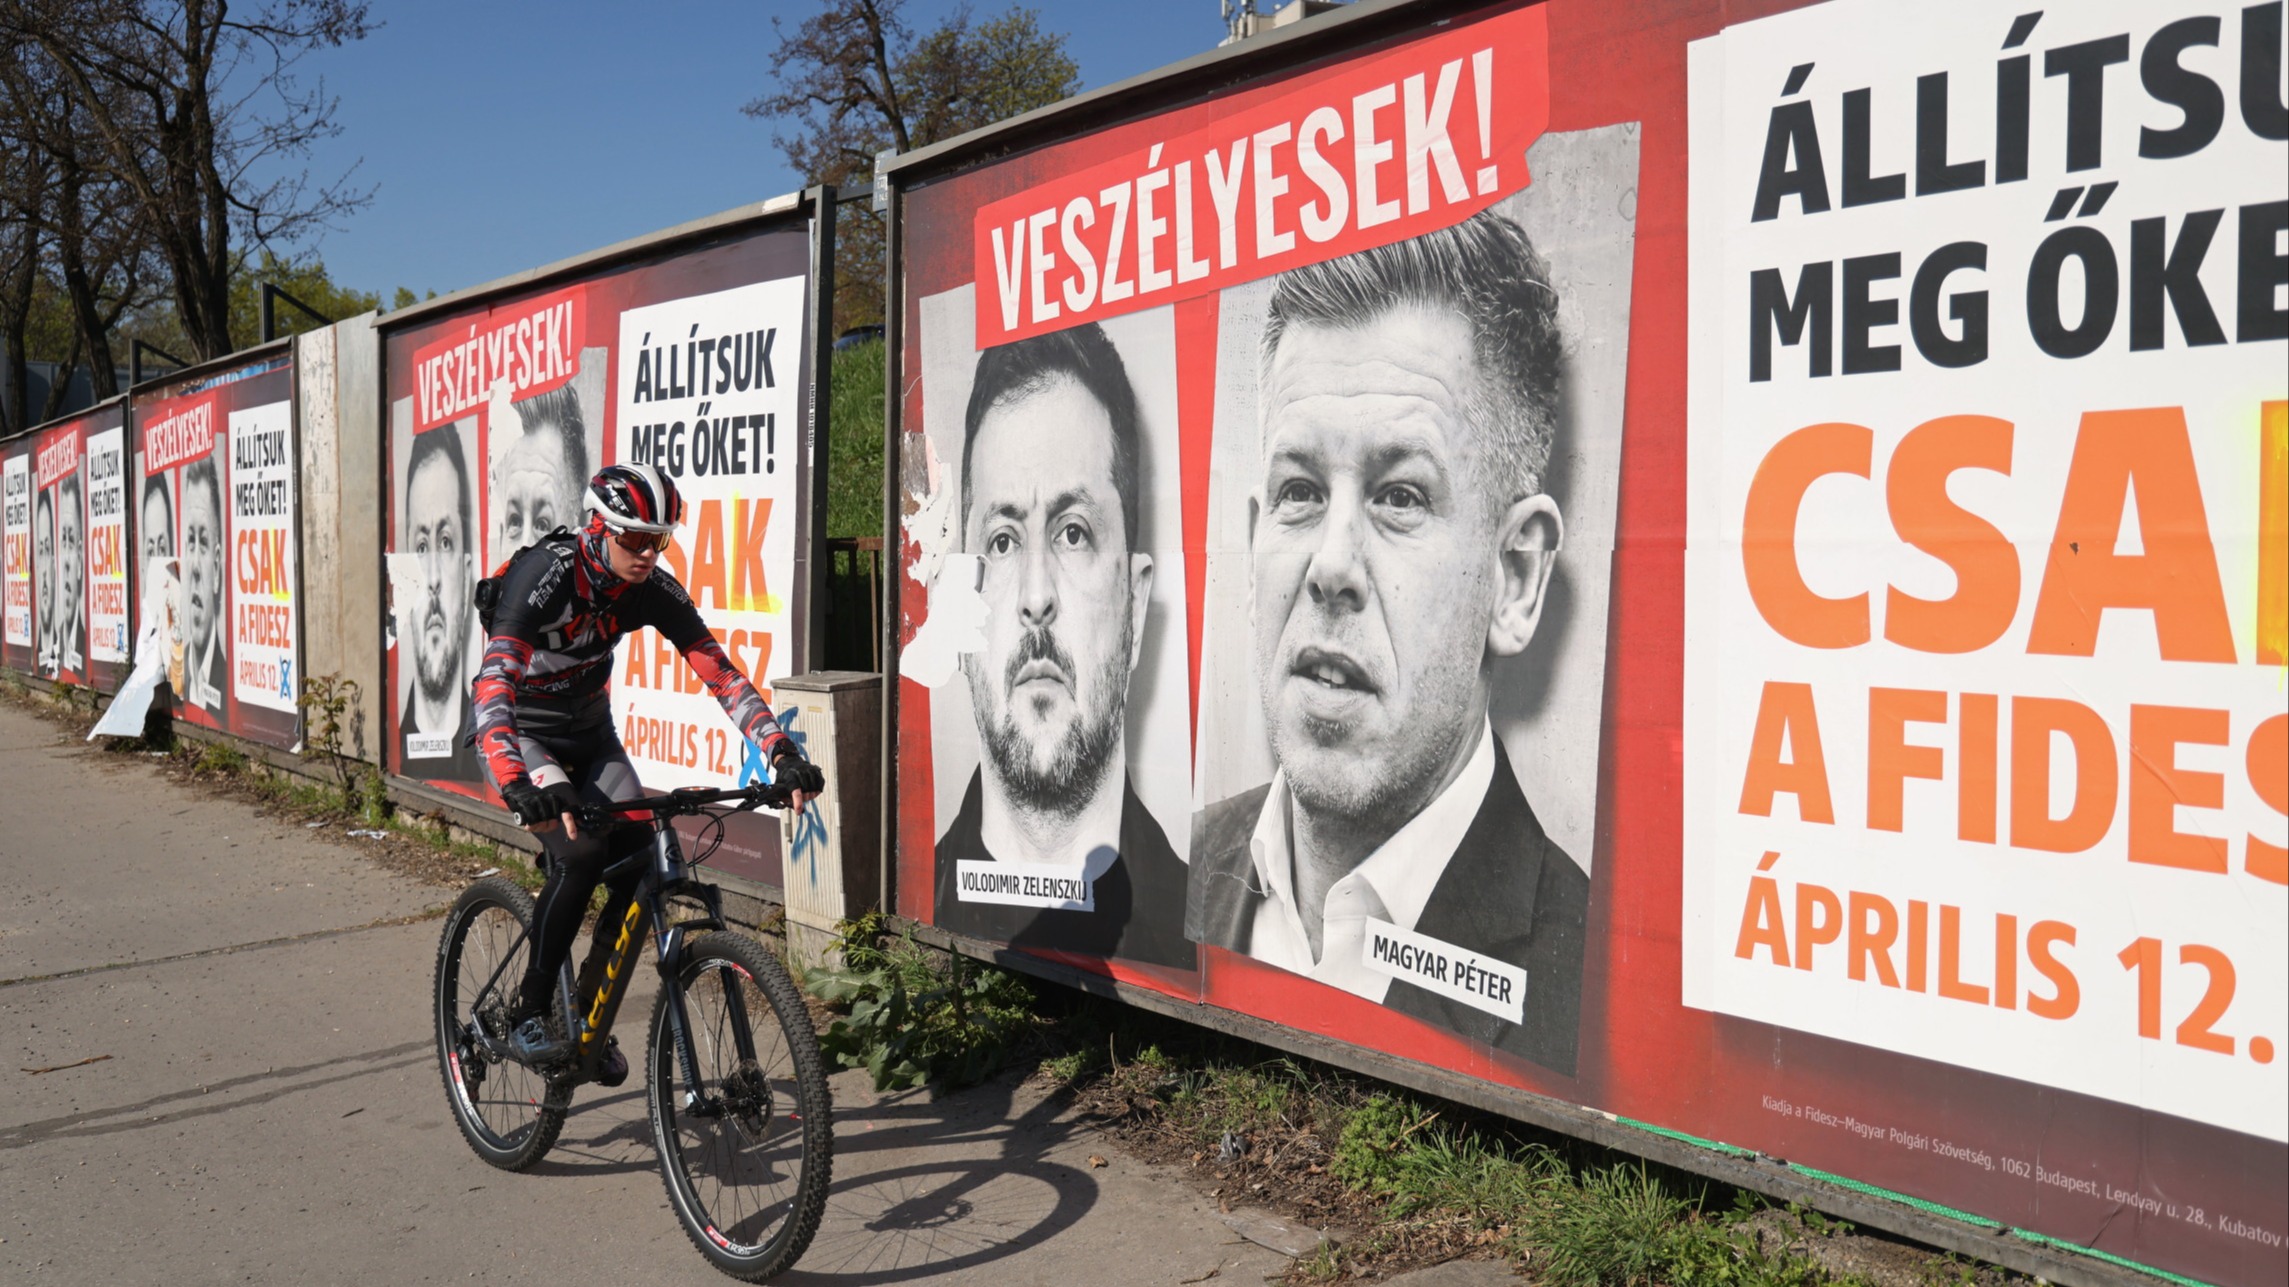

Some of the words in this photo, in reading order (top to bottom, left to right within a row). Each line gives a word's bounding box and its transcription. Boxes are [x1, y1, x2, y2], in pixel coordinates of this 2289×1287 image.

[991, 47, 1499, 332] VESZÉLYESEK!
[1749, 241, 1989, 383] MEG
[418, 300, 573, 425] VESZÉLYESEK!
[633, 323, 777, 404] ÁLLÍTSUK
[146, 401, 212, 472] VESZÉLYESEK!
[235, 423, 285, 471] ÁLLÍTSUK
[631, 421, 685, 478] MEG
[692, 401, 775, 477] ŐKET!
[236, 482, 255, 517] MEG
[257, 471, 287, 516] ŐKET!
[92, 524, 122, 576] CSAK
[237, 529, 288, 594] CSAK
[1742, 400, 2288, 666] CSA
[98, 583, 123, 615] FIDESZ
[239, 603, 247, 644] A
[248, 604, 290, 649] FIDESZ
[239, 652, 267, 690] ÁPRILIS
[267, 664, 278, 692] 12.
[625, 627, 648, 689] A
[624, 702, 698, 768] ÁPRILIS
[705, 727, 733, 776] 12.
[1738, 681, 1835, 825] A
[962, 872, 1020, 895] VOLODIMIR
[1023, 876, 1087, 902] ZELENSZKIJ
[1373, 934, 1448, 982] MAGYAR
[1454, 959, 1512, 1004] PÉTER
[1734, 850, 2081, 1022] ÁPRILIS
[2117, 936, 2275, 1065] 12.
[1762, 1095, 1793, 1117] Kiadja
[1795, 1108, 1801, 1117] a
[1890, 1127, 1929, 1151] Polgári
[1932, 1138, 1995, 1171] Szövetség,
[2001, 1157, 2031, 1179] 1062
[2036, 1166, 2100, 1199] Budapest,
[2106, 1184, 2162, 1216] Lendvay
[2167, 1204, 2179, 1219] u.
[2186, 1205, 2212, 1230] 28.,
[2219, 1214, 2281, 1247] Kubatov
